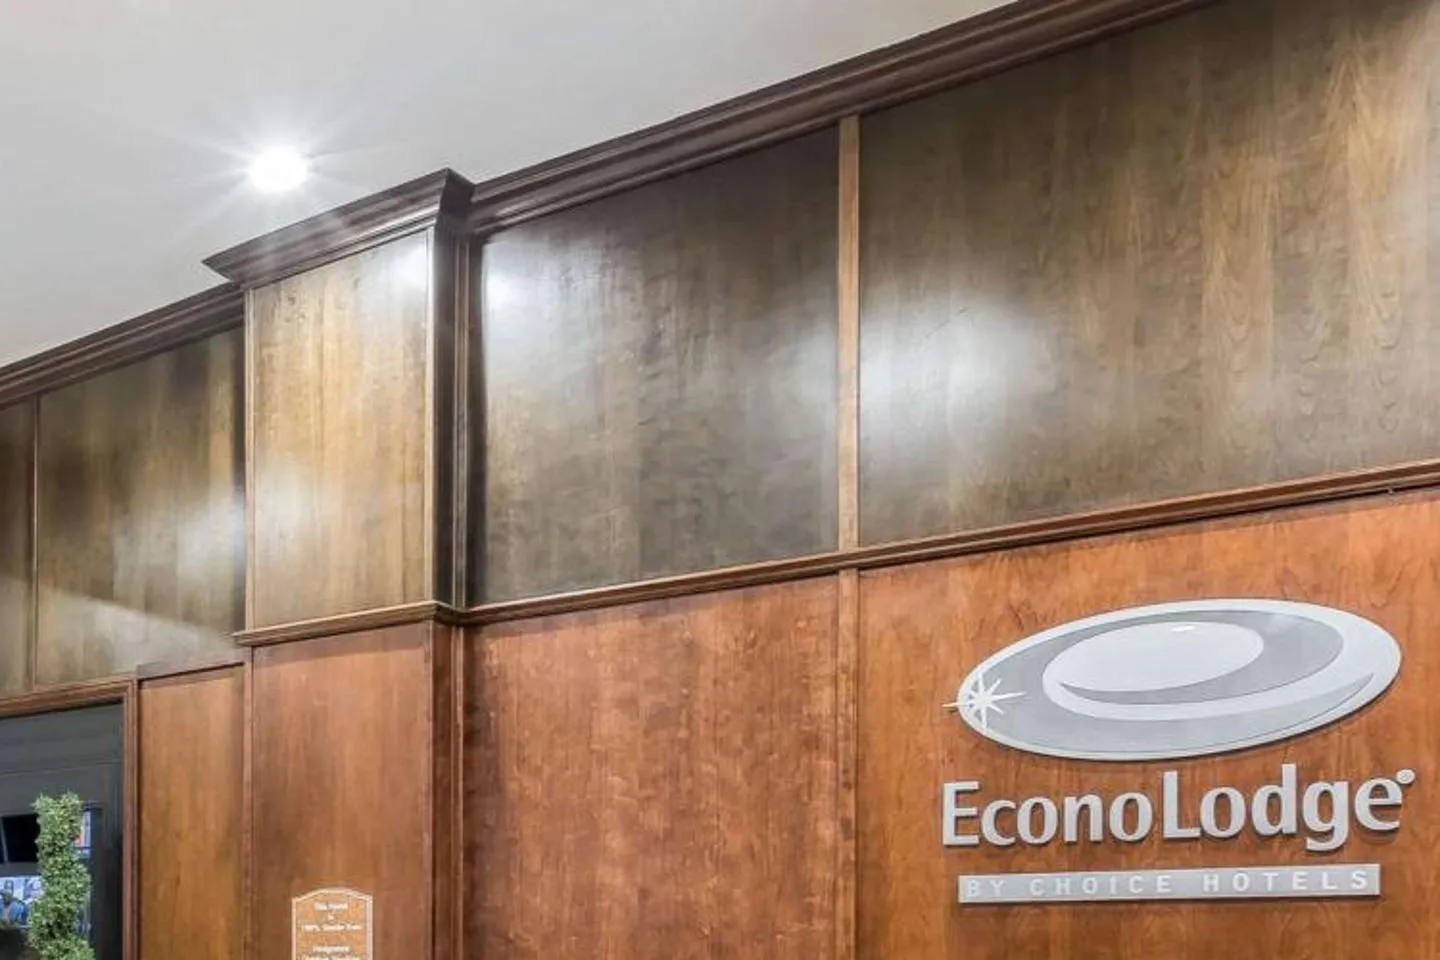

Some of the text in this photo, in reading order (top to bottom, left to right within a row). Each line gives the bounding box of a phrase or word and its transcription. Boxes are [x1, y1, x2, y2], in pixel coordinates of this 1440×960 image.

[966, 870, 1371, 899] BY CHOICE HOTELS
